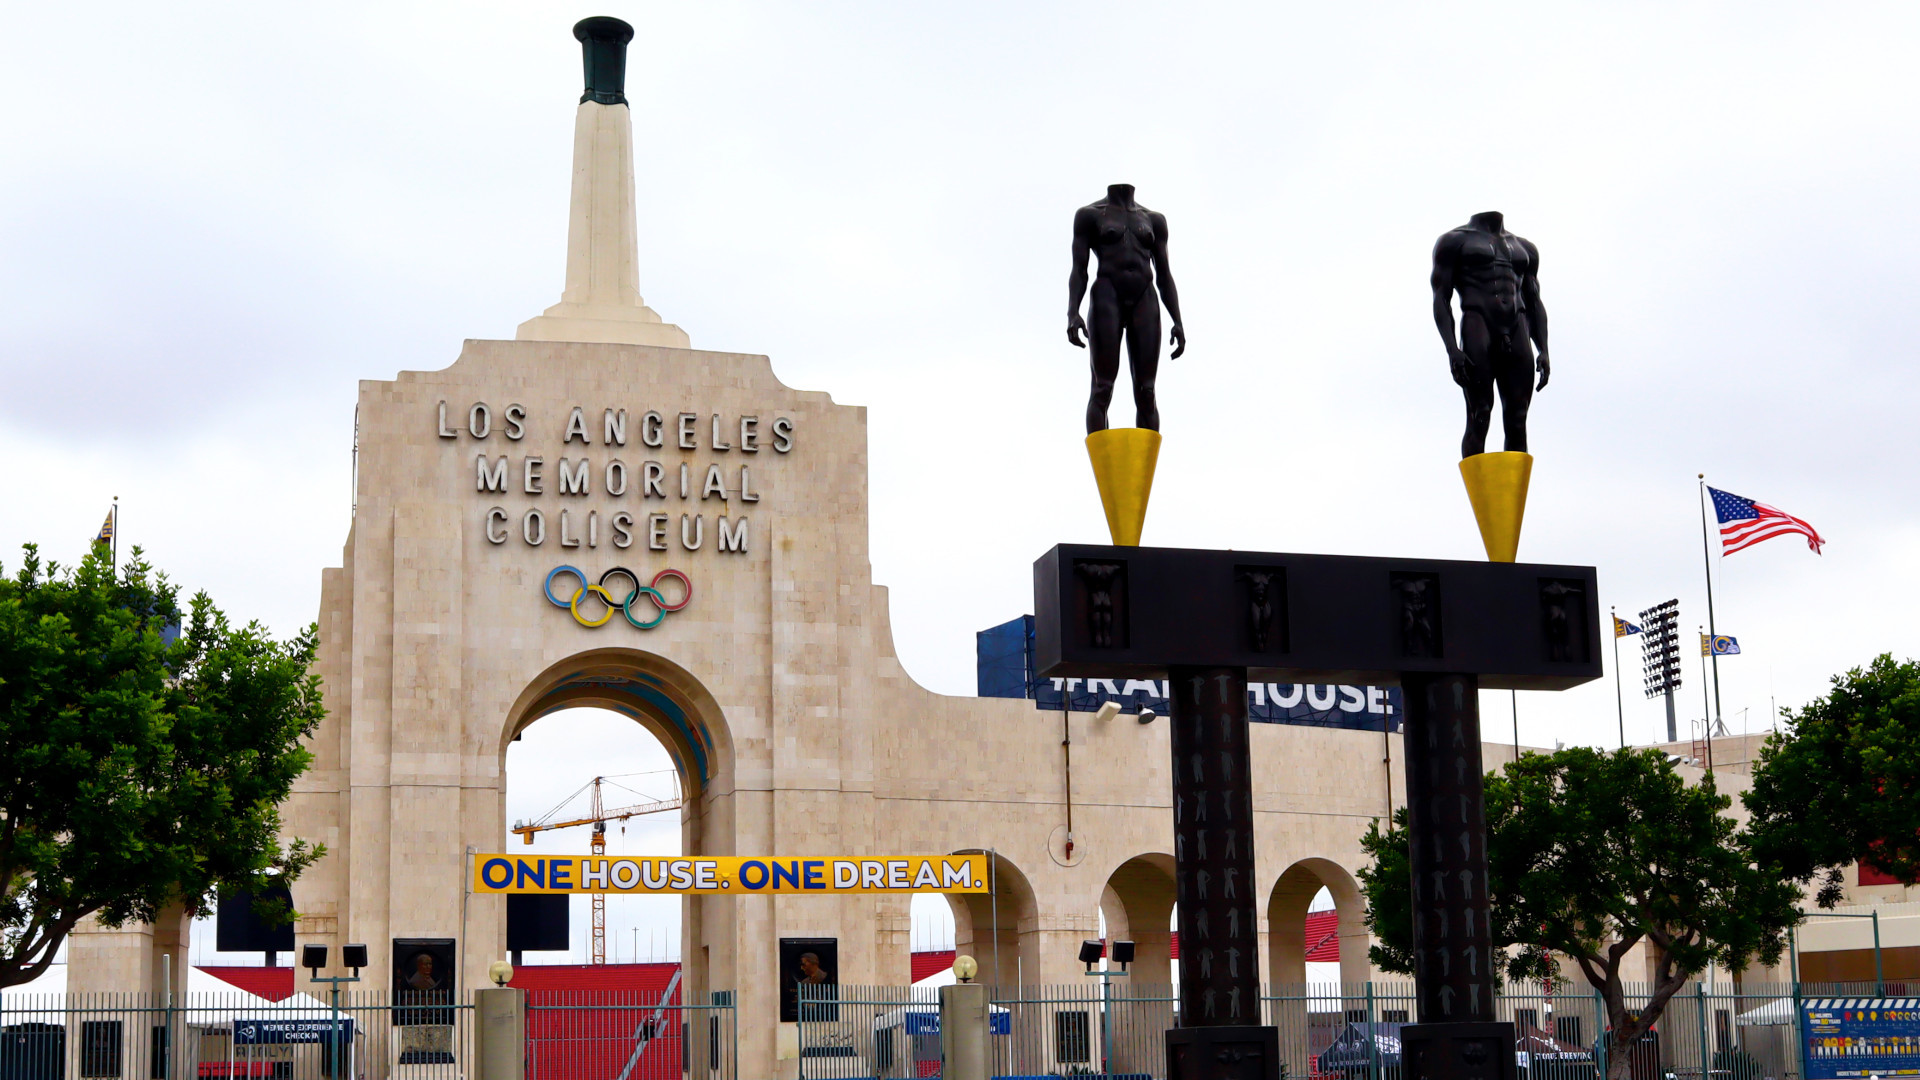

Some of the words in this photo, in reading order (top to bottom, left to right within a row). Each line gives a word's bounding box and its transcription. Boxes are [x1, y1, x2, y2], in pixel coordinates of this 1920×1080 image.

[437, 400, 527, 441] LOS
[563, 405, 794, 453] ANGELES
[476, 454, 760, 502] MEMORIAL
[486, 506, 749, 553] COLISEUM
[481, 858, 573, 889] ONE
[581, 860, 730, 890] HOUSE.
[738, 860, 826, 890] ONE
[833, 860, 983, 889] DREAM.
